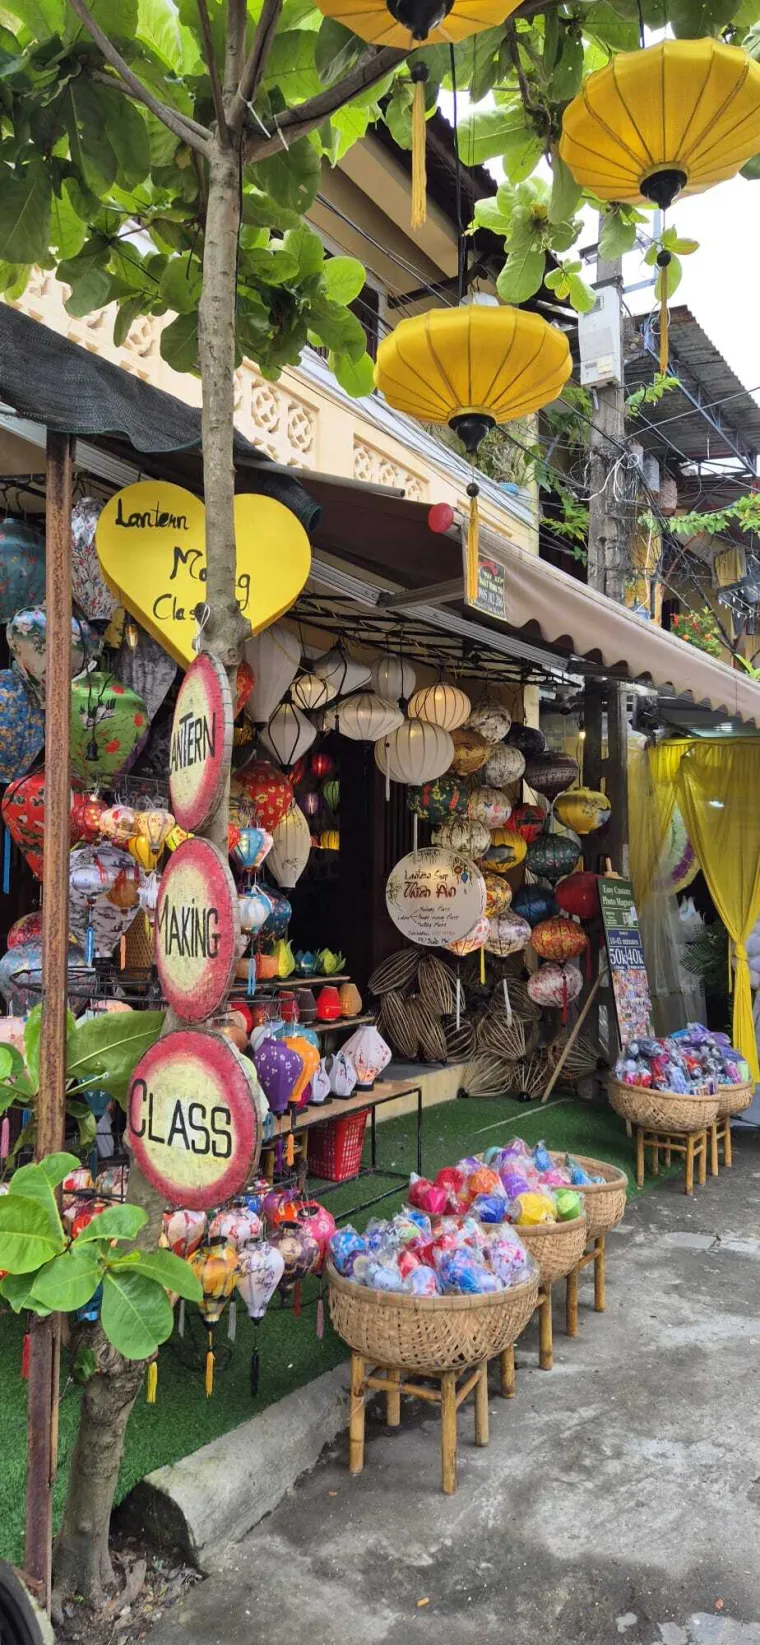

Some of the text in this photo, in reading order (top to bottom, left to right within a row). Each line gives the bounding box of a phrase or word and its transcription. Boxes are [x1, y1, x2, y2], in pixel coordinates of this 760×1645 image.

[115, 498, 190, 531] Lantern
[169, 711, 217, 777] ANTERN
[129, 1078, 232, 1159] CLASS
